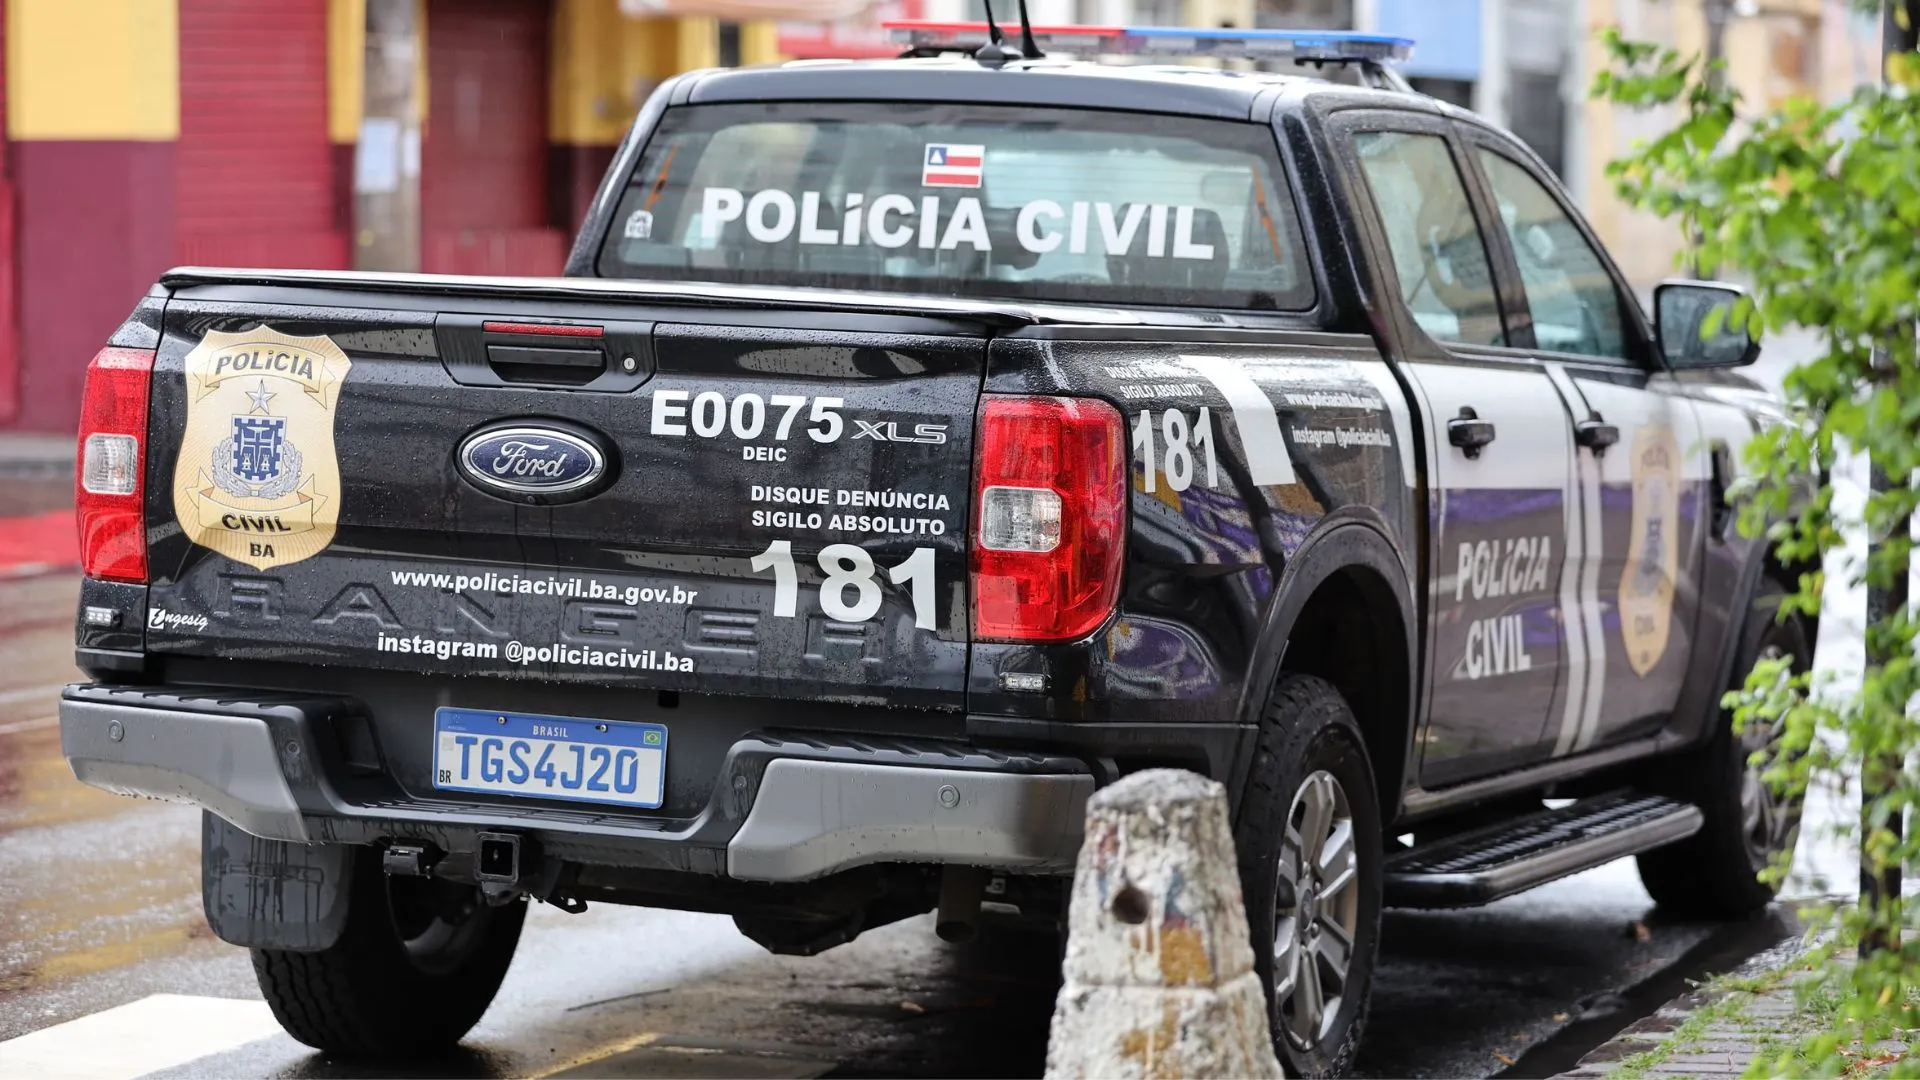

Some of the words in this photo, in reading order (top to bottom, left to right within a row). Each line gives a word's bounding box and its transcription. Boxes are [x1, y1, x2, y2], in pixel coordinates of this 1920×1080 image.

[1016, 200, 1214, 260] CIVIL
[1120, 385, 1155, 399] SIGILO
[1155, 383, 1203, 398] ABSOLUTO
[650, 389, 844, 443] E0075
[851, 420, 948, 445] XLS
[743, 446, 787, 462] DEIC
[1132, 406, 1218, 493] 181
[1292, 425, 1336, 448] instagram
[493, 441, 567, 477] Ford
[751, 485, 829, 505] DISQUE
[837, 488, 950, 511] DENÚNCIA
[222, 514, 291, 533] CIVIL
[752, 511, 822, 529] SIGILO
[829, 515, 945, 535] ABSOLUTO
[250, 543, 275, 558] BA
[391, 570, 697, 605] www.policiacivil.ba.gov.br
[751, 540, 936, 631] 181
[213, 571, 884, 663] RANGER
[377, 632, 498, 660] instagram
[505, 640, 694, 673] @policiacivil.ba
[1466, 614, 1531, 680] CIVIL
[532, 725, 569, 738] BRASIL
[439, 769, 451, 783] BR
[455, 736, 638, 793] TGS4J20
